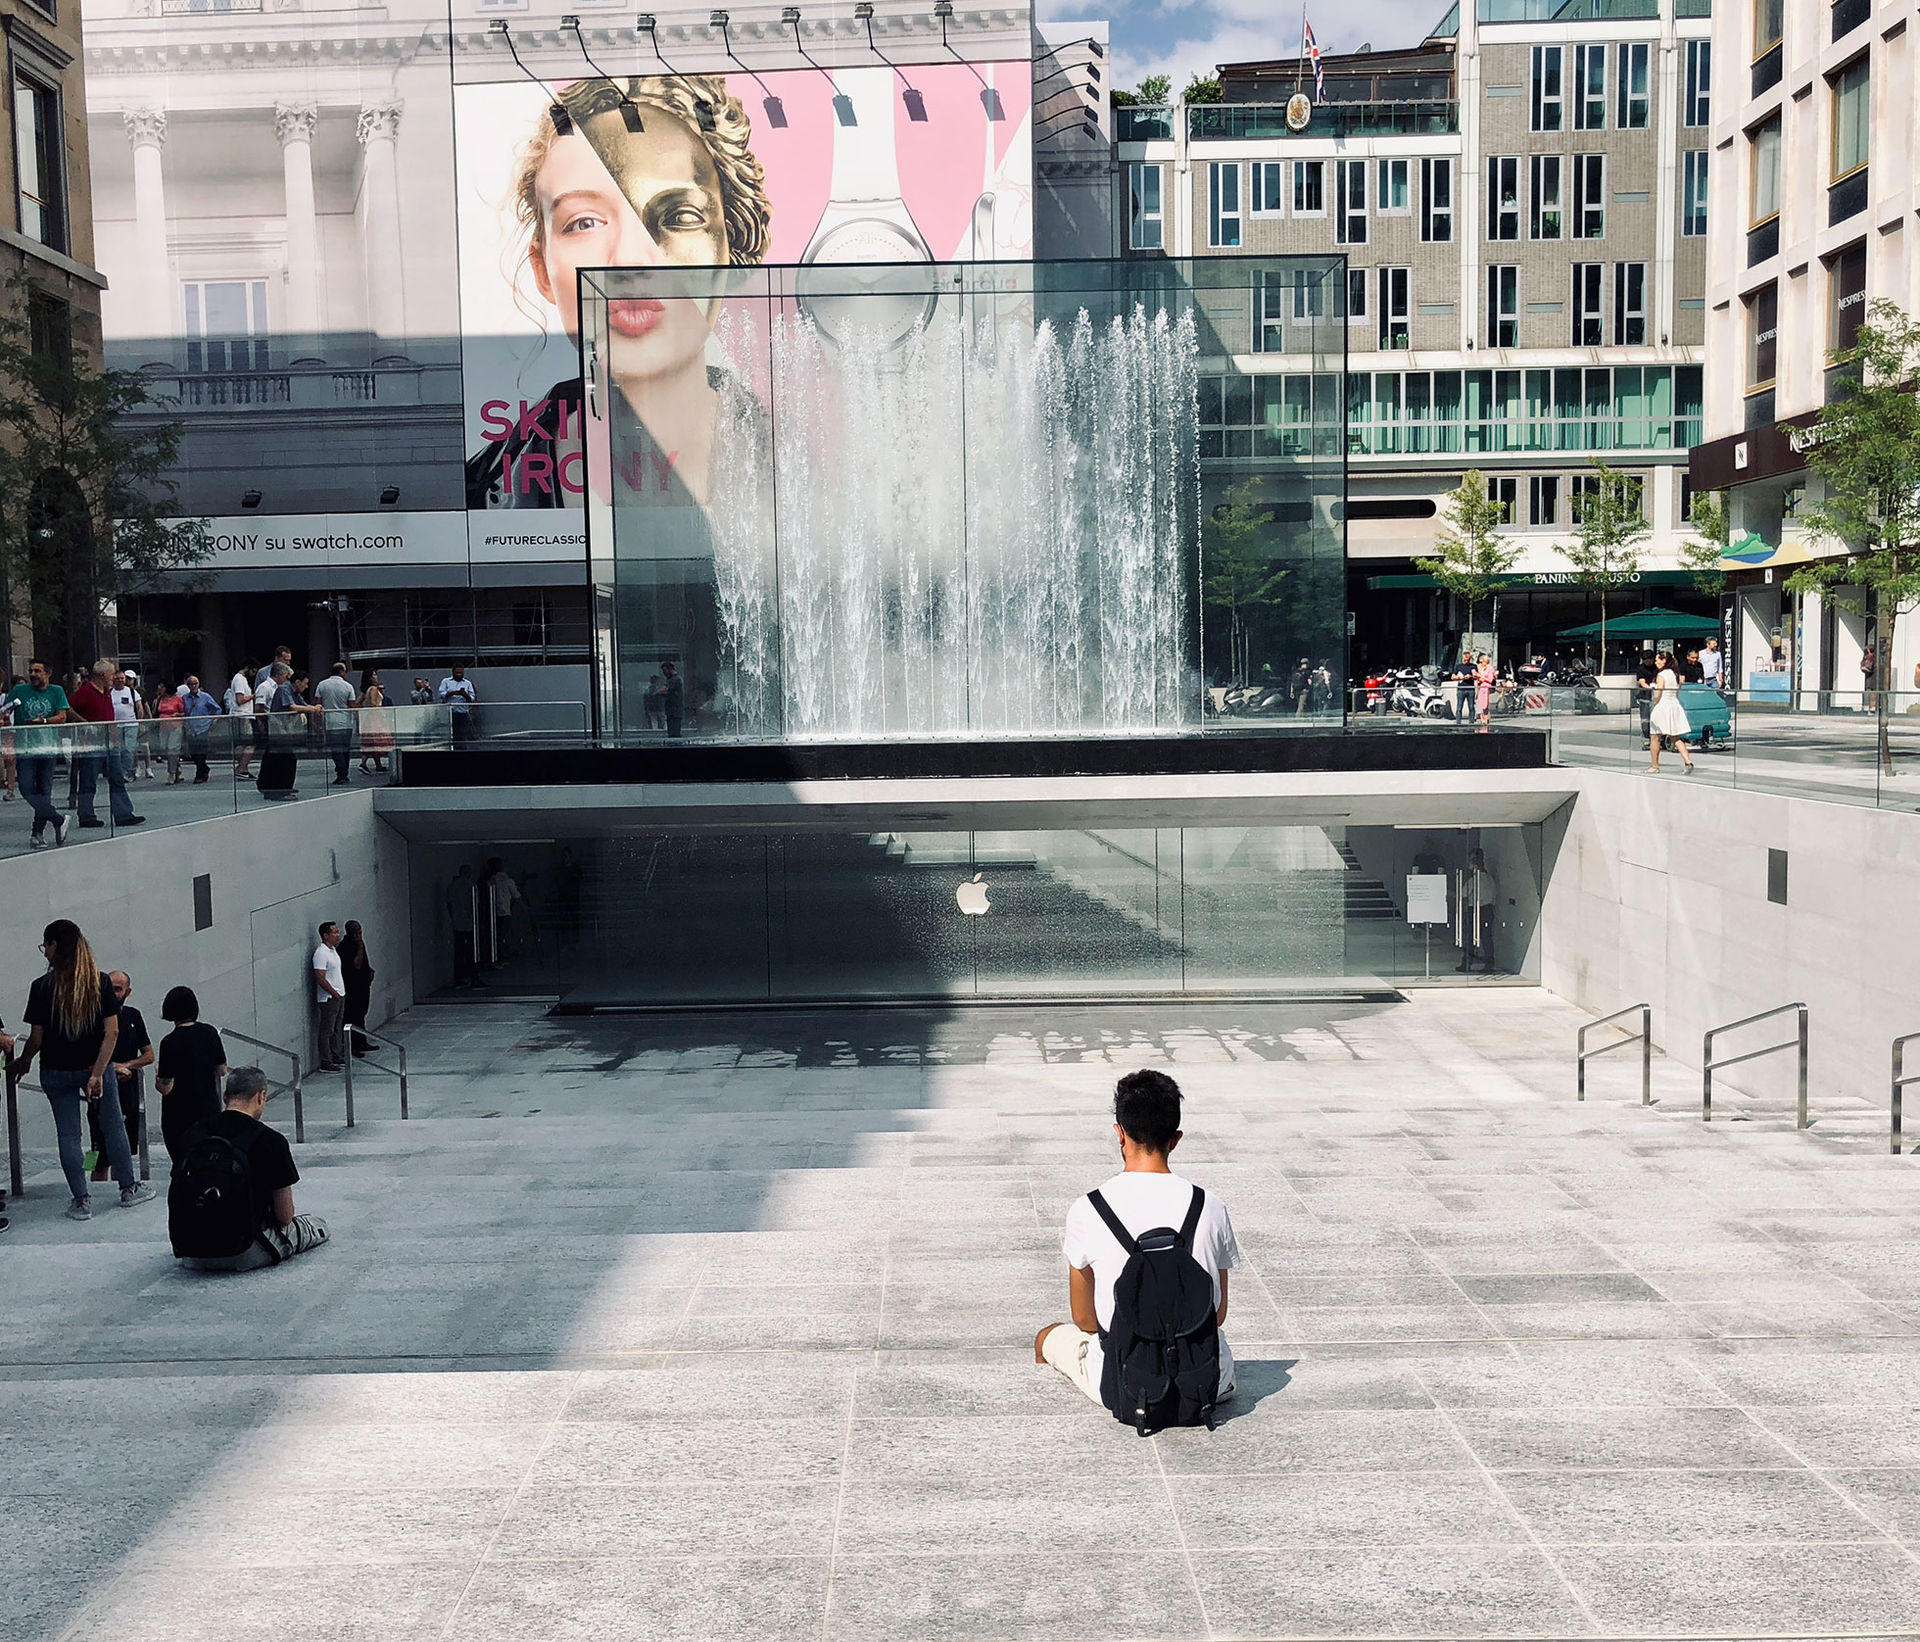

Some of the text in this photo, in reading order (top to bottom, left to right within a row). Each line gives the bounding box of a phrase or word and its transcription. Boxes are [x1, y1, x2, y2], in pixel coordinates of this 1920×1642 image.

[265, 540, 286, 550] su
[292, 533, 403, 550] swatch.com
[1594, 572, 1641, 584] GUSTO
